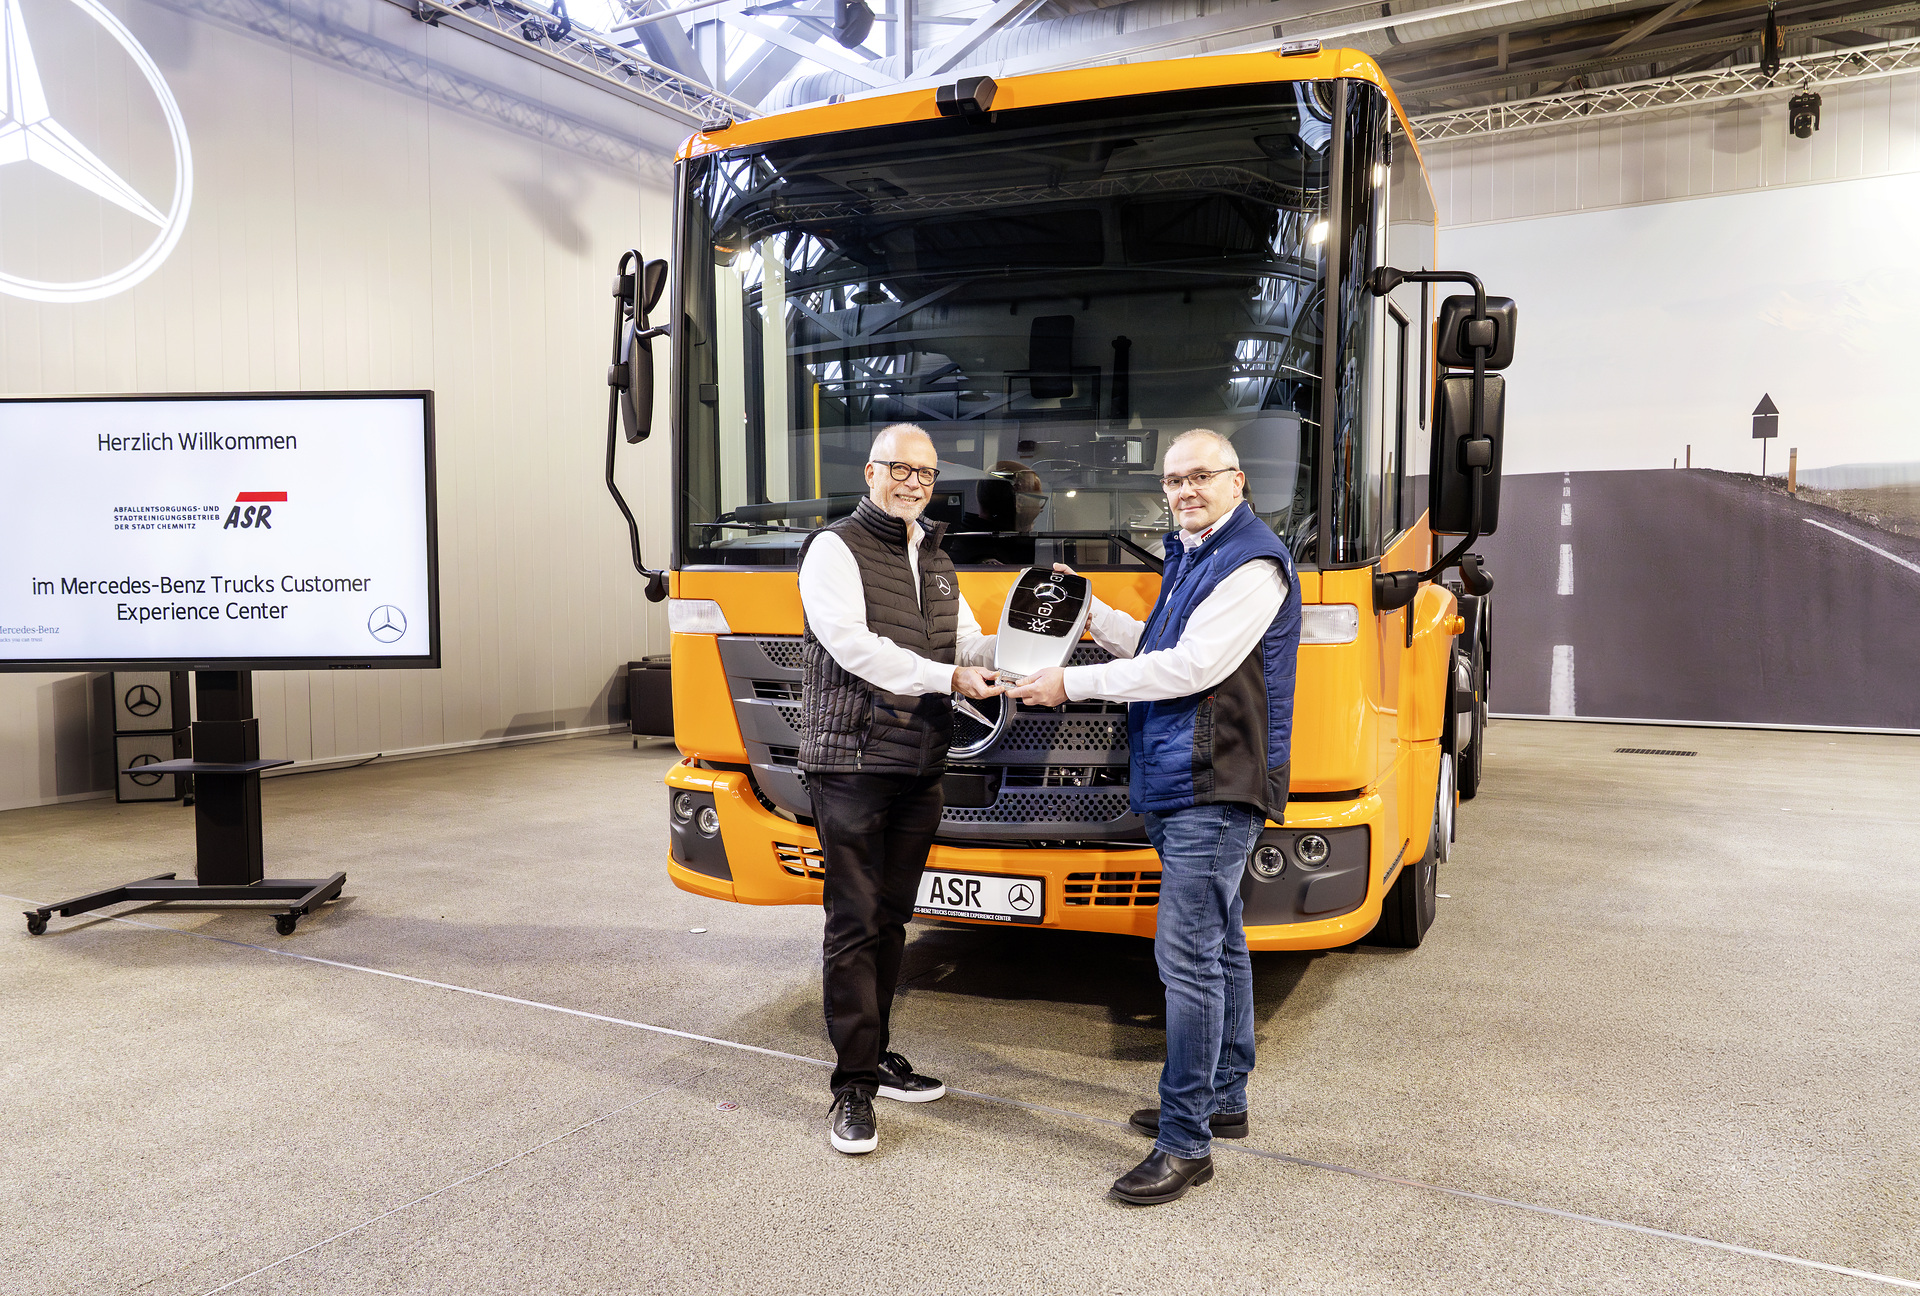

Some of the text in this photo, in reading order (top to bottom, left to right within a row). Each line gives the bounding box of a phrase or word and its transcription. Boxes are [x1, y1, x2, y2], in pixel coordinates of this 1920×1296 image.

[98, 431, 297, 451] Herzlich Willkommen
[223, 505, 272, 530] ASR
[32, 575, 371, 595] im Mercedes-Benz Trucks Customer
[117, 602, 288, 624] Experience Center
[930, 876, 981, 908] ASR
